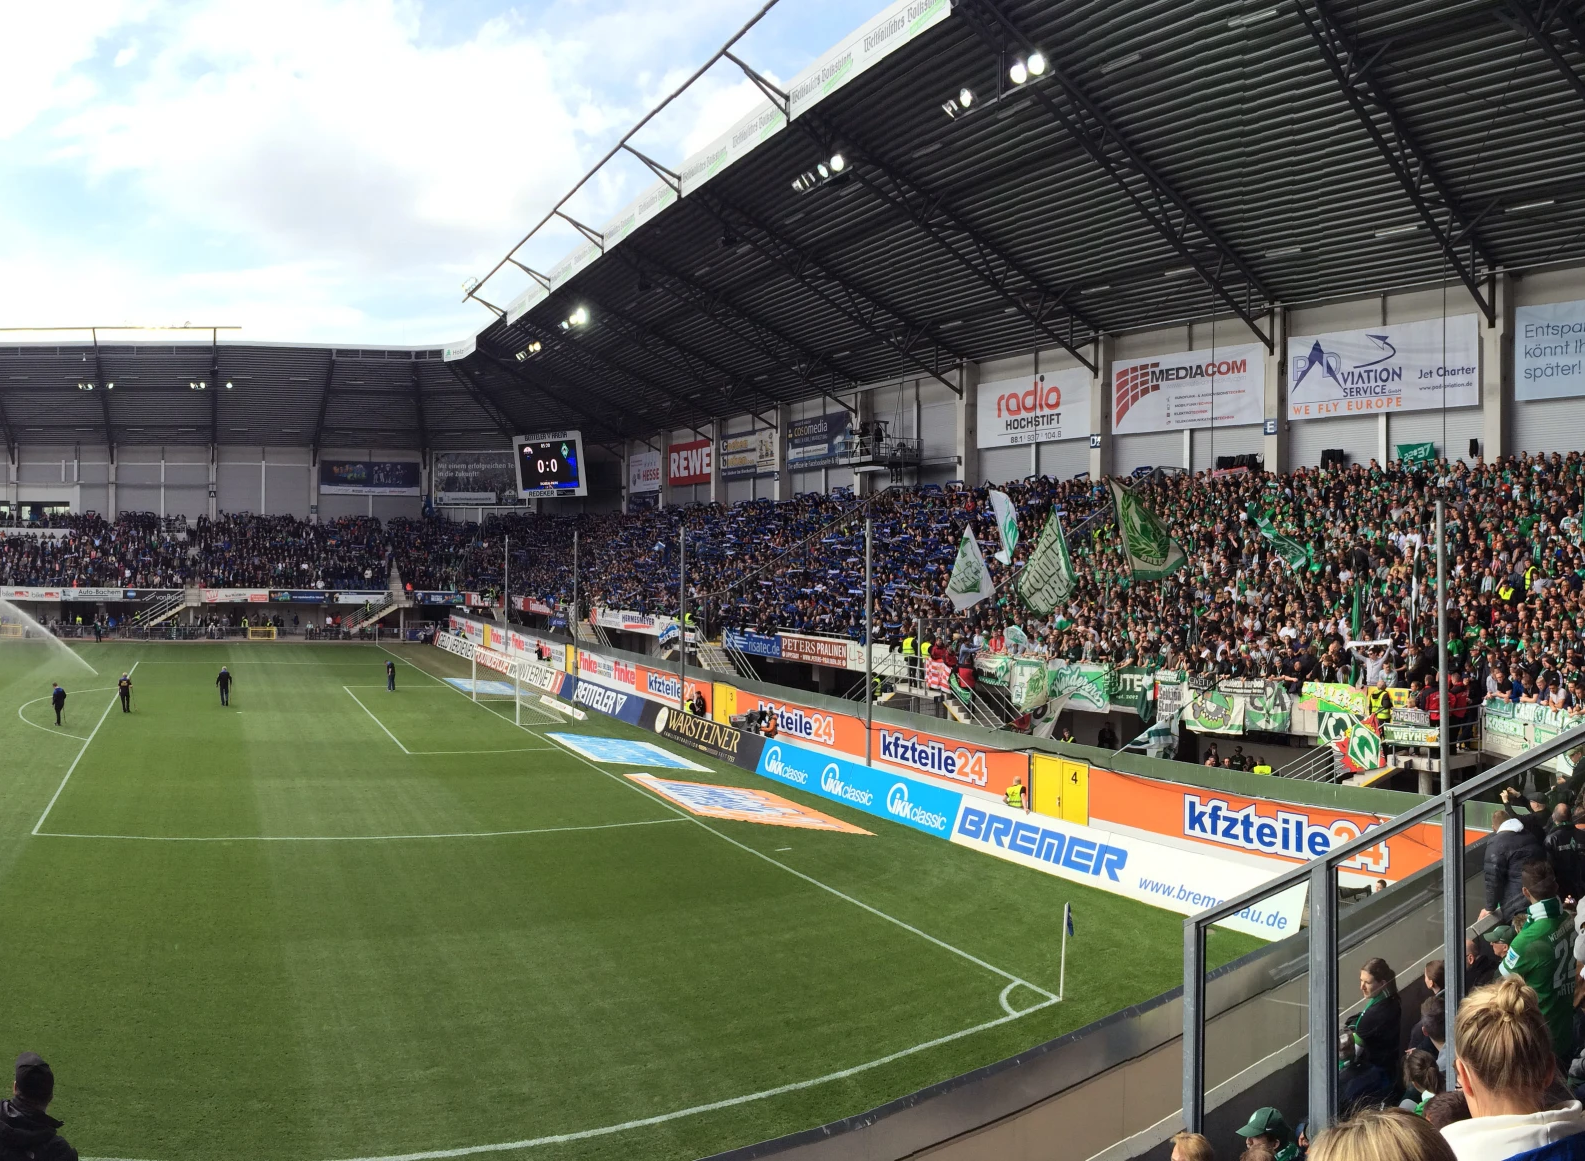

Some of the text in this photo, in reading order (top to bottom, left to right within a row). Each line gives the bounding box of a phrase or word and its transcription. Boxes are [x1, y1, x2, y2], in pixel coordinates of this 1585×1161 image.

[1525, 323, 1585, 339] Entspa
[1525, 340, 1571, 360] könnt
[1150, 358, 1247, 384] MEDIACOM
[1418, 366, 1476, 381] Jet Charter
[1524, 360, 1581, 383] später!
[997, 375, 1061, 418] radio
[1342, 385, 1387, 398] SERVICE
[1293, 396, 1402, 415] WE FLY EUROPE
[1005, 413, 1061, 431] HOCHSTIFT
[1267, 421, 1275, 433] E
[1010, 436, 1023, 444] 88.1
[1044, 431, 1062, 440] 104.8
[468, 463, 504, 471] erfolgreichen
[537, 459, 558, 473] 0:0
[670, 447, 711, 479] REWE
[642, 467, 660, 482] HESSE
[529, 489, 554, 497] REDEKER
[78, 588, 122, 596] Auto-Bachem
[621, 614, 655, 626] HERMESMEYER
[781, 637, 847, 659] PETERS PRALINEN
[580, 651, 636, 685] finke finke
[1052, 665, 1105, 710] Wanderers
[574, 680, 617, 714] BENTELER
[730, 692, 734, 702] 3
[1393, 711, 1430, 725] PAPENBURG
[668, 709, 741, 754] WARSTEINER
[1393, 730, 1427, 741] WEYHE
[881, 730, 987, 785] kfzteile24
[782, 765, 809, 785] classic
[1070, 772, 1079, 785] 4
[841, 784, 874, 806] classic
[910, 806, 947, 831] classic
[957, 806, 1128, 882] BREMER
